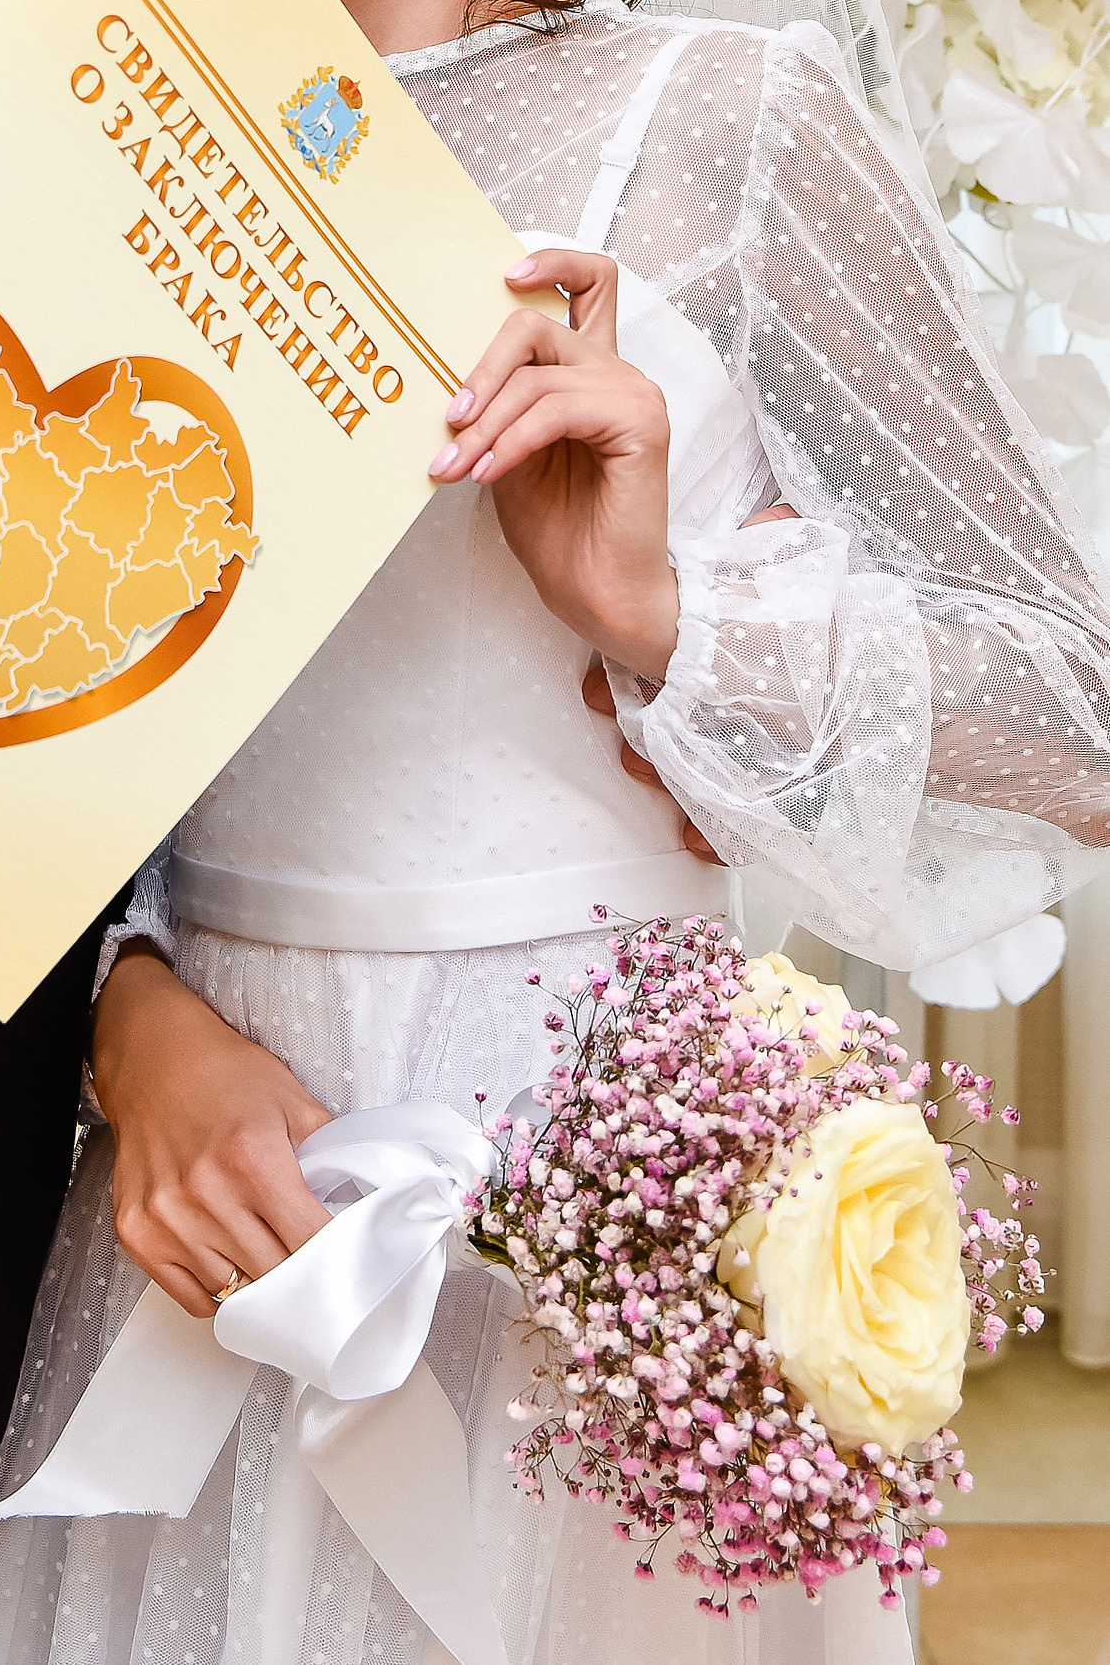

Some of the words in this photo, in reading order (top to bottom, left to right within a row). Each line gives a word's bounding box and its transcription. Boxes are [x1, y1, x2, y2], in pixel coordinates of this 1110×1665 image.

[70, 63, 105, 104] О
[101, 101, 371, 440] ЗАКЛЮЧЕНИИ
[96, 14, 404, 404] СВИДЕТЕЛЬСТВО
[122, 209, 244, 373] БРАКА
